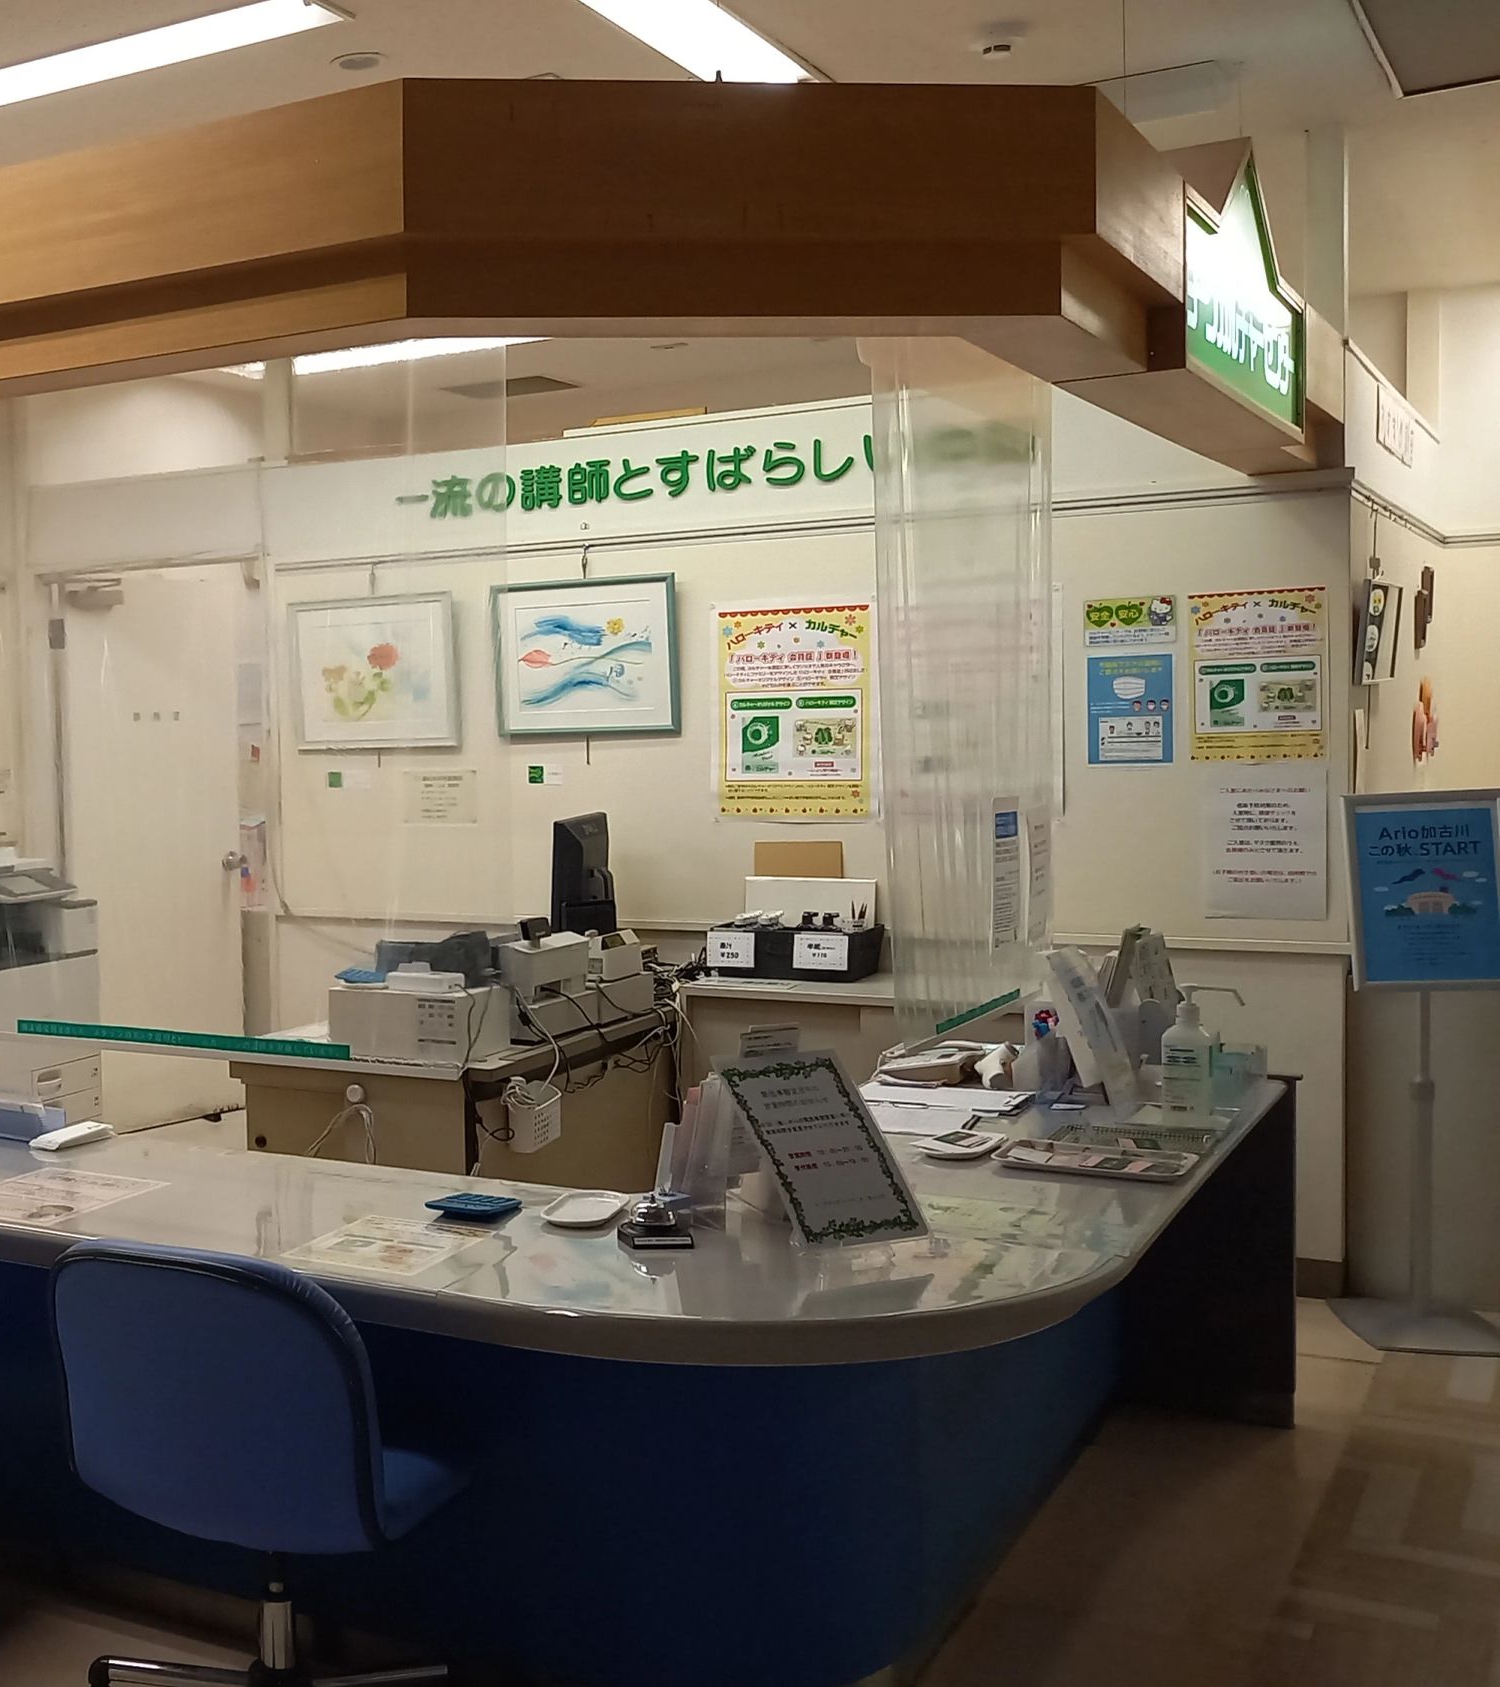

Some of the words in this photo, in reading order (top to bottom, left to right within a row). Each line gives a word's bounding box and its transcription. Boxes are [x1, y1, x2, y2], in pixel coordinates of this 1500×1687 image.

[726, 622, 784, 650] ハローキティ
[805, 619, 857, 639] カルチャー
